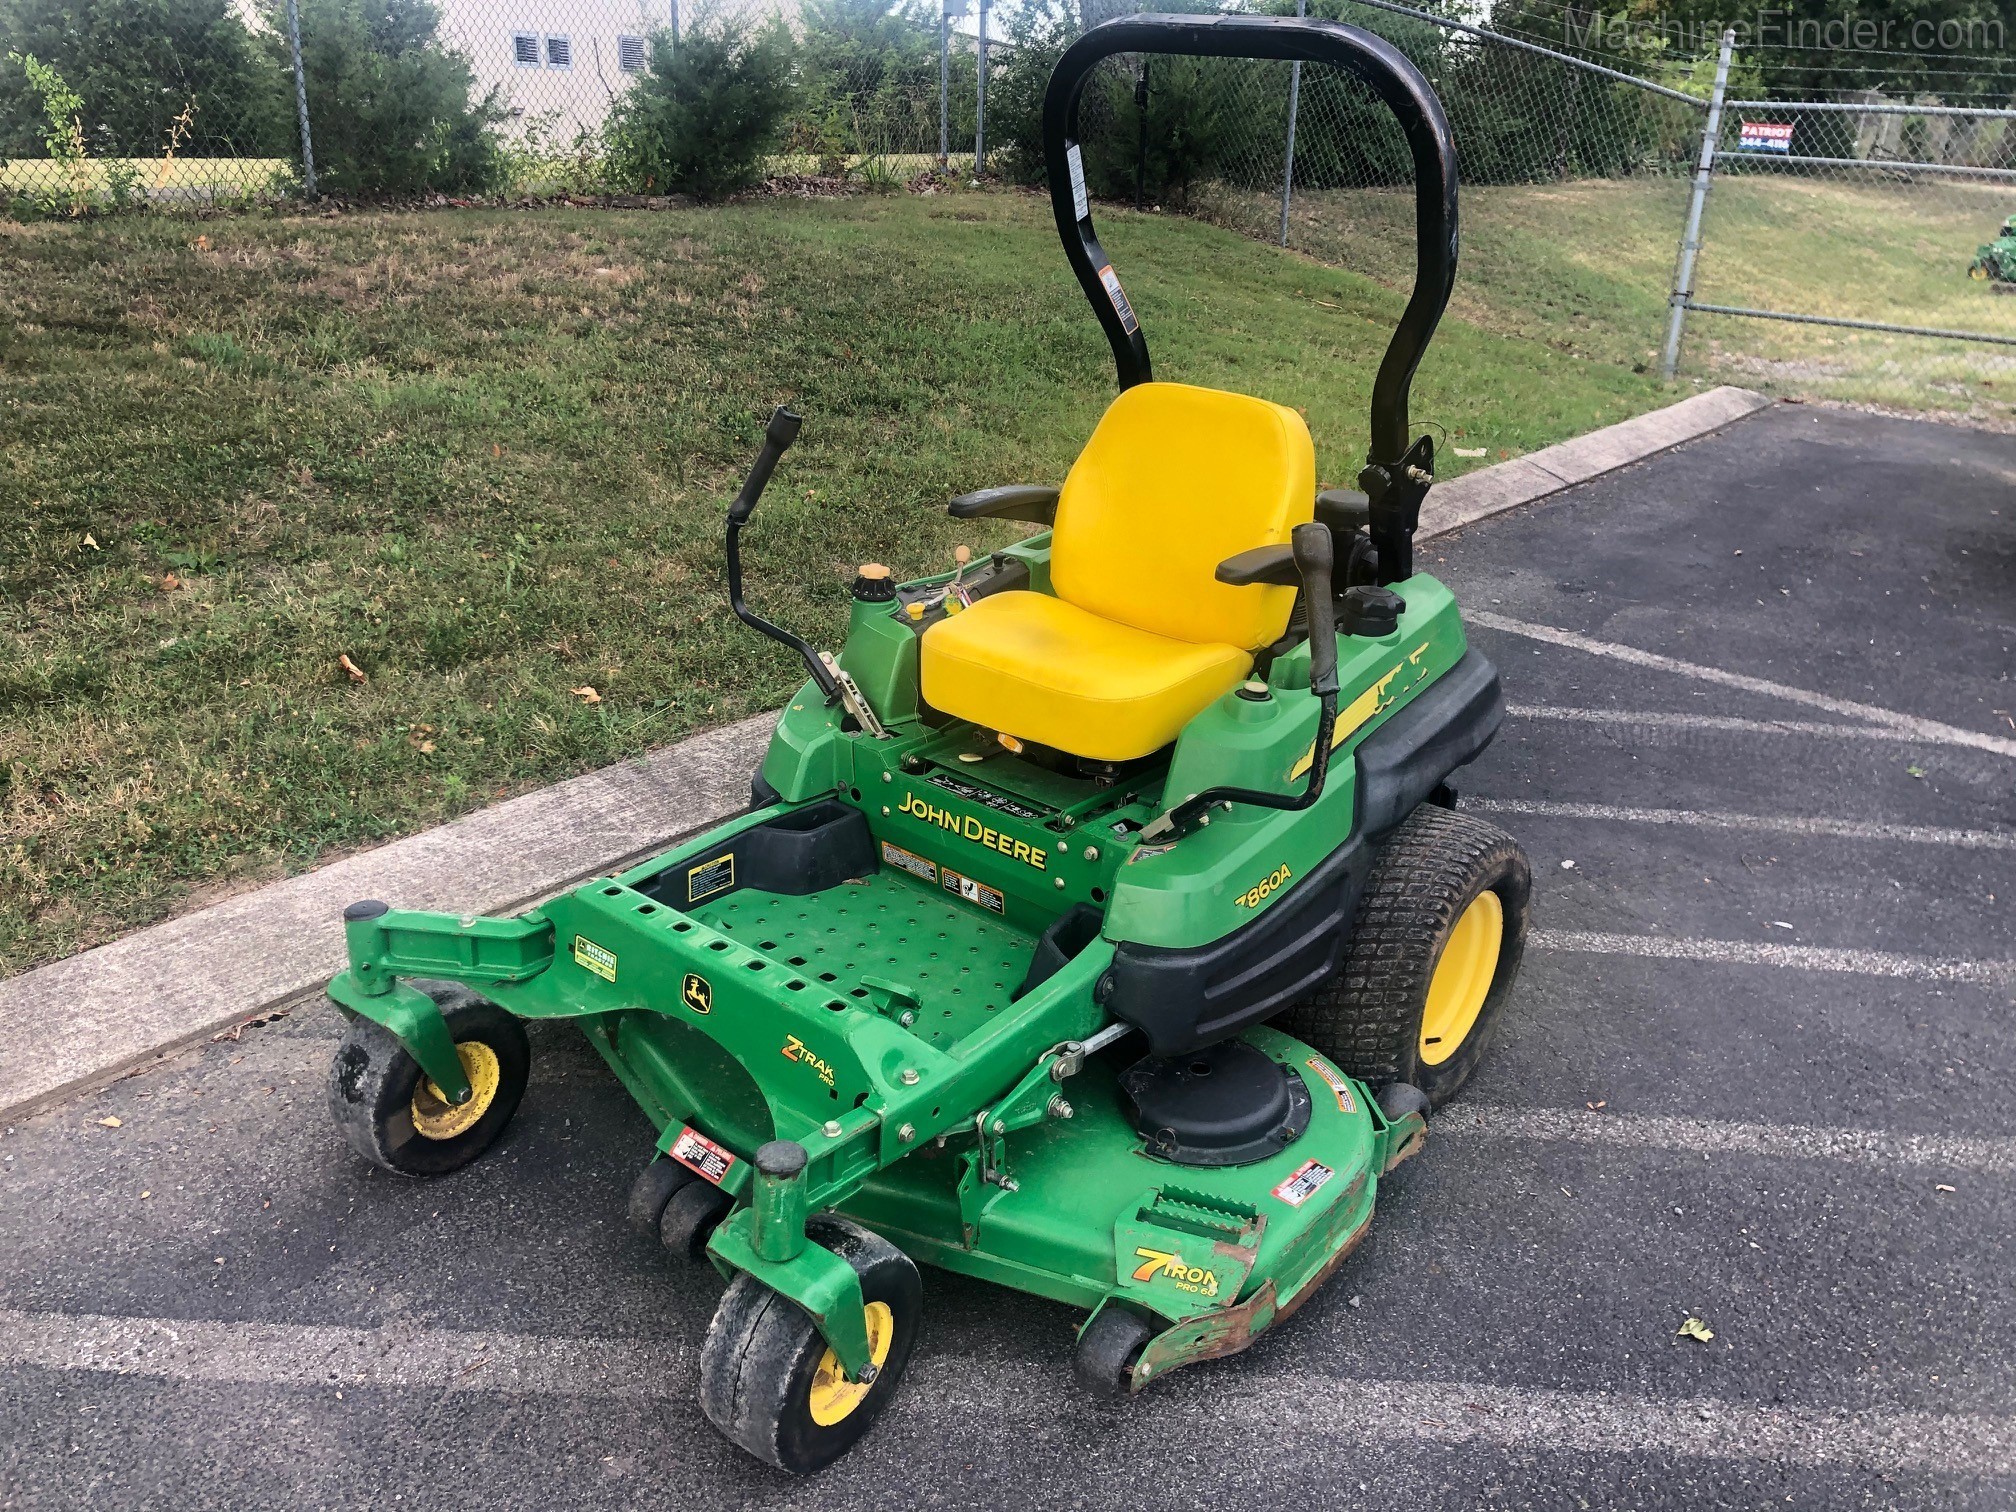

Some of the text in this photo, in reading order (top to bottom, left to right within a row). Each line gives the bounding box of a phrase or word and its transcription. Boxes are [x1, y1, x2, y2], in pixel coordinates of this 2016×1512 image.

[1741, 125, 1793, 138] PATRIOT
[898, 791, 960, 834] JOHN
[964, 815, 1048, 870] DEERE
[818, 1072, 835, 1087] PRO
[1175, 1281, 1198, 1293] PRO
